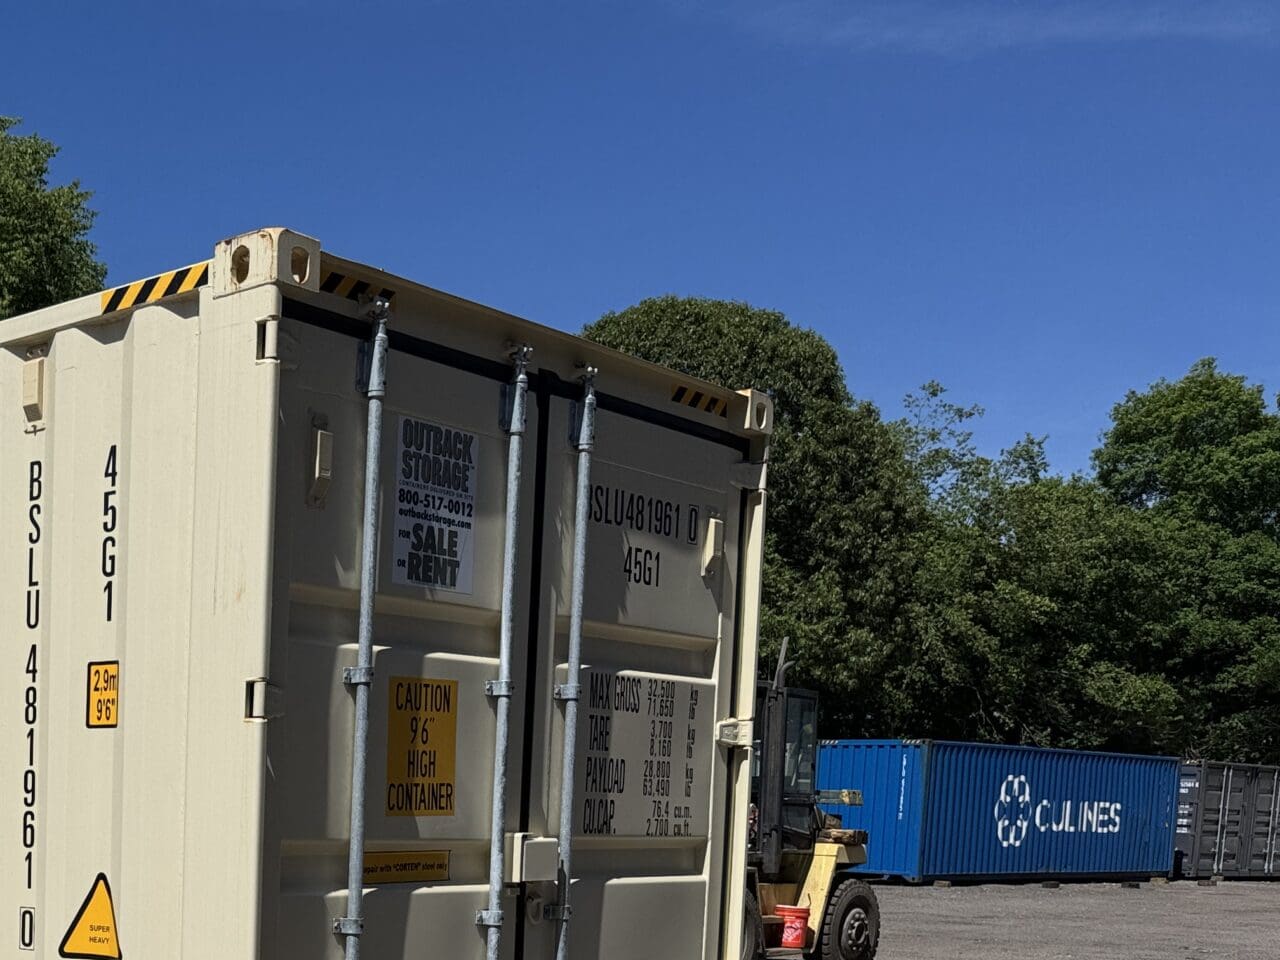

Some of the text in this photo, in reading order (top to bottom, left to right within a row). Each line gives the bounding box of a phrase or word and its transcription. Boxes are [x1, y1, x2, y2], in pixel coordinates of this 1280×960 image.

[402, 418, 474, 464] OUTBACK
[398, 488, 473, 517] 800-517-0012
[398, 507, 472, 529] outbackstorage.com
[26, 460, 42, 629] BSLU
[102, 444, 118, 622] 45G1
[398, 523, 458, 558] FOR SALE
[397, 558, 406, 568] OR
[407, 552, 460, 587] RENT
[624, 546, 660, 587] 45G1
[395, 682, 451, 713] CAUTION
[589, 672, 611, 709] MAX
[614, 675, 641, 713] GROSS
[589, 714, 611, 751] TARE
[23, 644, 38, 889] 481961
[407, 749, 436, 778] HIGH
[585, 757, 625, 793] PAYLOAD
[387, 782, 453, 812] CONTAINER
[89, 924, 110, 932] SUPER
[89, 936, 109, 944] HEAVY
